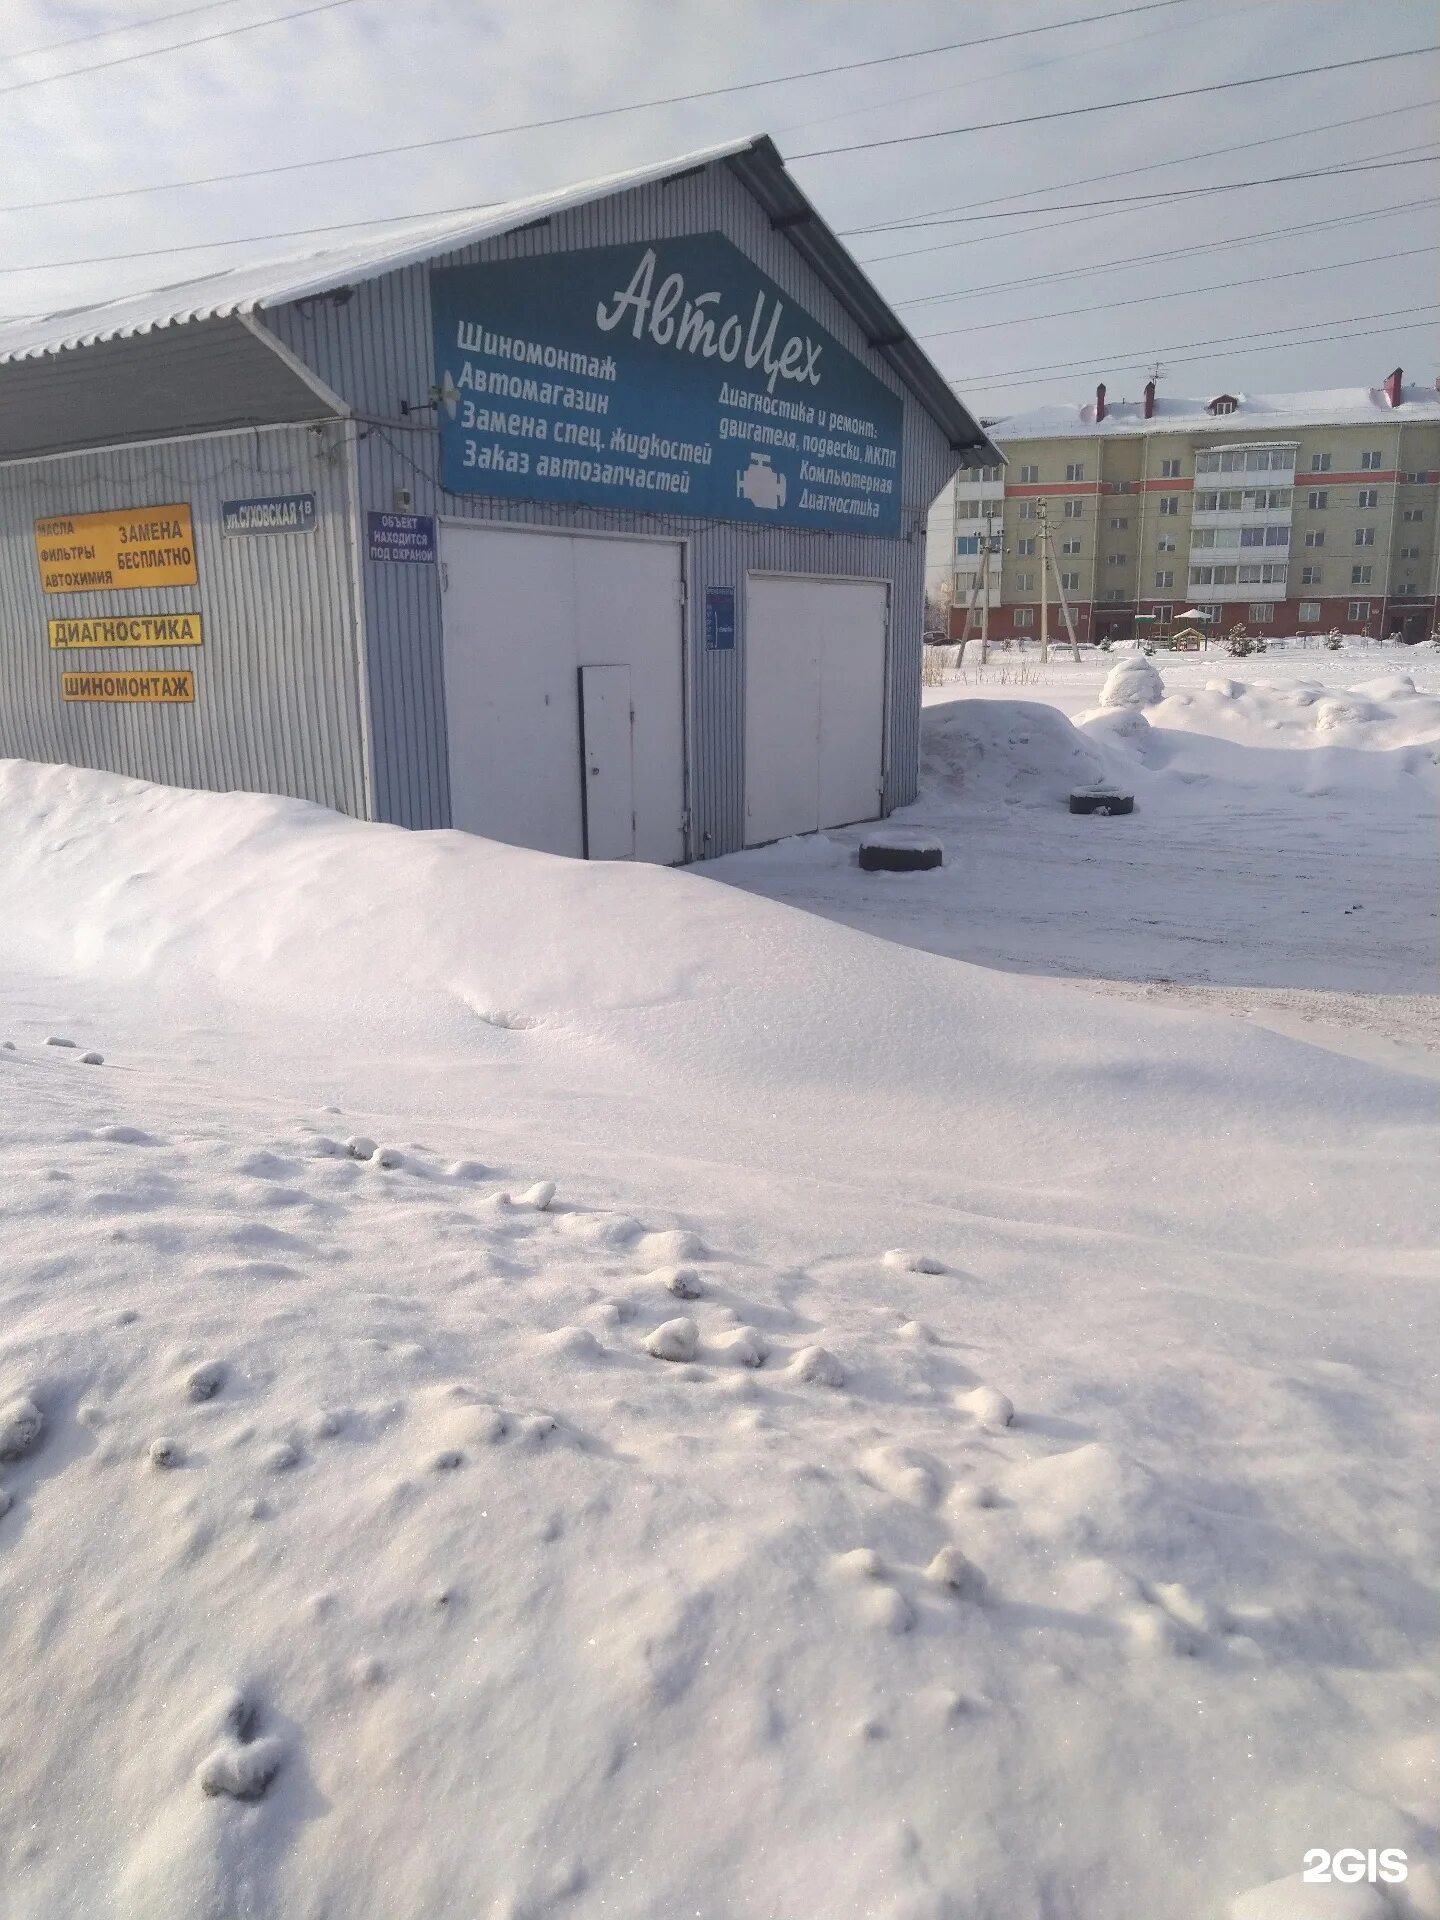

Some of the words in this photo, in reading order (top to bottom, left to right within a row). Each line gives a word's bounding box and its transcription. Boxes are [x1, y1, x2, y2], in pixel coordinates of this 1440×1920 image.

[596, 247, 822, 393] АвтоЦех
[456, 320, 617, 382] Шиномонтаж
[457, 361, 609, 415] Автомагазин
[718, 382, 815, 425] Диагностика
[818, 409, 826, 426] и
[461, 400, 548, 440] Замена
[553, 421, 606, 454] спец.
[609, 426, 713, 466] жидкостей
[462, 439, 530, 475] Заказ
[536, 453, 691, 494] автозапчастей
[863, 444, 897, 468] МКПП
[800, 459, 893, 495] Компьютерная
[798, 487, 880, 518] Диагностика
[37, 521, 75, 537] МАСЛА
[118, 520, 183, 544] ЗАМЕНА
[381, 514, 418, 530] ОБЪЕКТ
[373, 530, 428, 546] НАХОДИТСЯ
[40, 545, 96, 562] ФИЛЬТРЫ
[117, 547, 191, 570] БЕСПЛАТНО
[370, 546, 391, 561] ПОД
[392, 548, 433, 561] ОХРАНОЙ
[45, 570, 113, 588] АВТОХИМИЯ
[54, 619, 194, 644] ДИАГНОСТИКА
[64, 675, 189, 697] ШИНОМОНТАЖ
